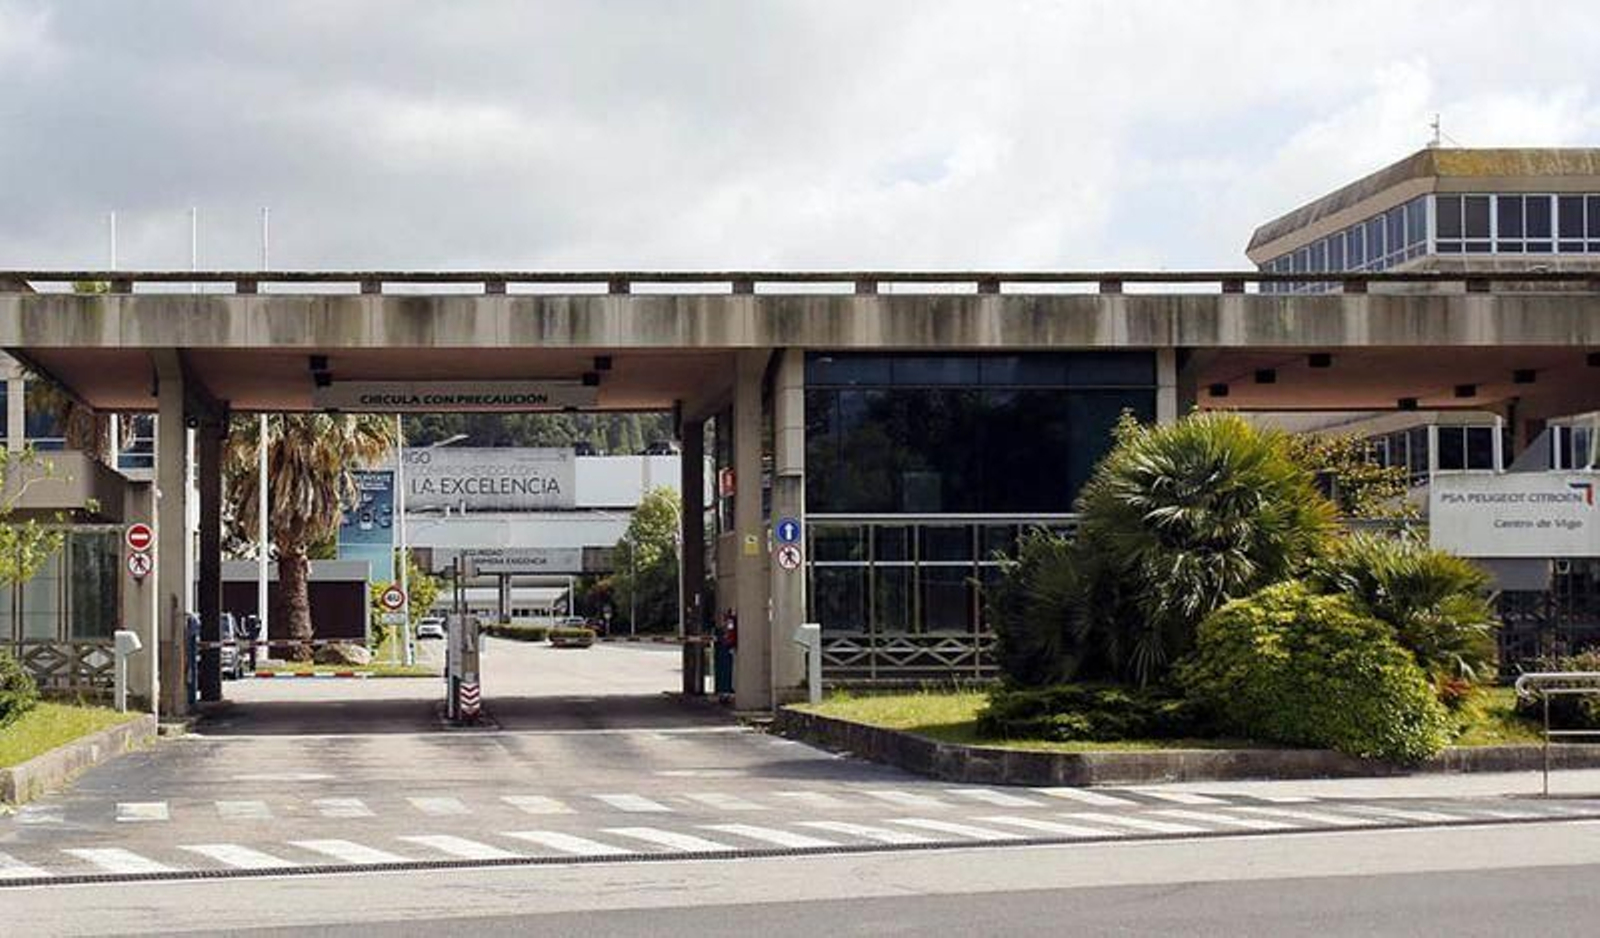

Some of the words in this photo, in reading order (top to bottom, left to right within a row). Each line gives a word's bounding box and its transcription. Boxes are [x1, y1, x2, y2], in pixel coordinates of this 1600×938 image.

[360, 394, 420, 405] CIRCULA
[423, 394, 456, 405] CON
[457, 392, 548, 405] PRECAUCIÓN
[412, 477, 435, 495] LA
[440, 477, 561, 495] EXCELENCIA
[1441, 493, 1466, 503] PSA
[1468, 493, 1526, 503] PEUGEOT
[1494, 519, 1533, 528] Centro
[1536, 519, 1551, 528] de
[1554, 519, 1583, 530] Vigo
